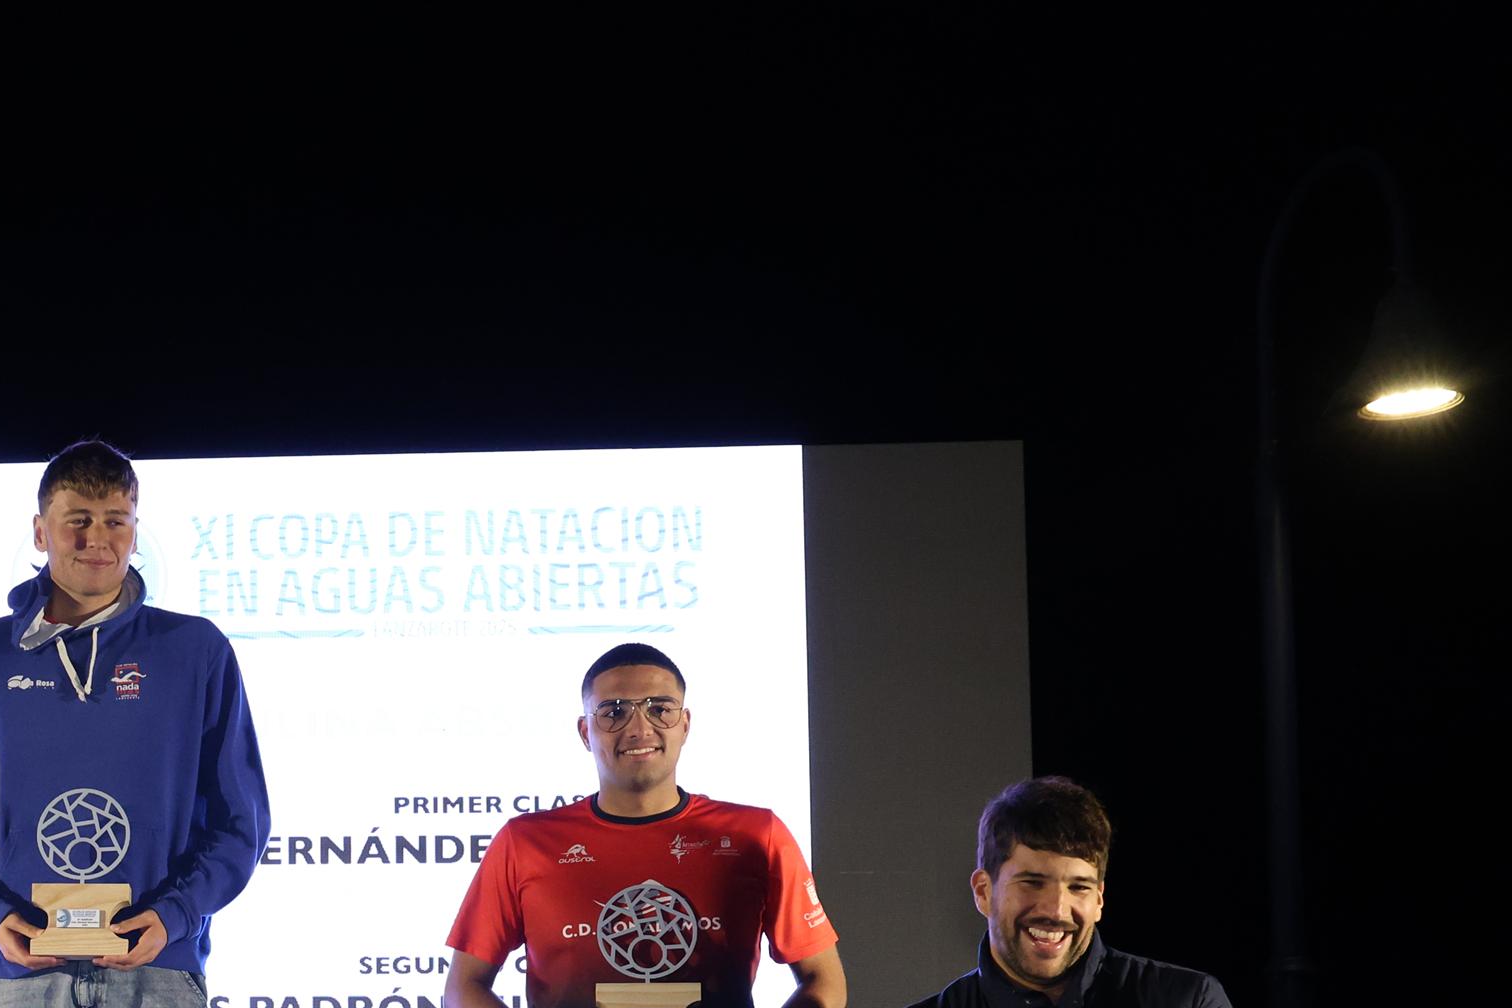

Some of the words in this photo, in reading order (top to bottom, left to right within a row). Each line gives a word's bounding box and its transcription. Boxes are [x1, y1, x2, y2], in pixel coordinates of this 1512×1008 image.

[191, 513, 234, 560] XI
[249, 511, 370, 561] COPA
[388, 510, 445, 557] DE
[464, 505, 703, 556] NATACION
[198, 568, 258, 616] EN
[275, 565, 445, 616] AGUAS
[463, 561, 699, 614] ABIERTAS
[393, 796, 503, 814] PRIMER
[259, 827, 493, 865] ERNÁNDE
[562, 923, 597, 938] C.D.
